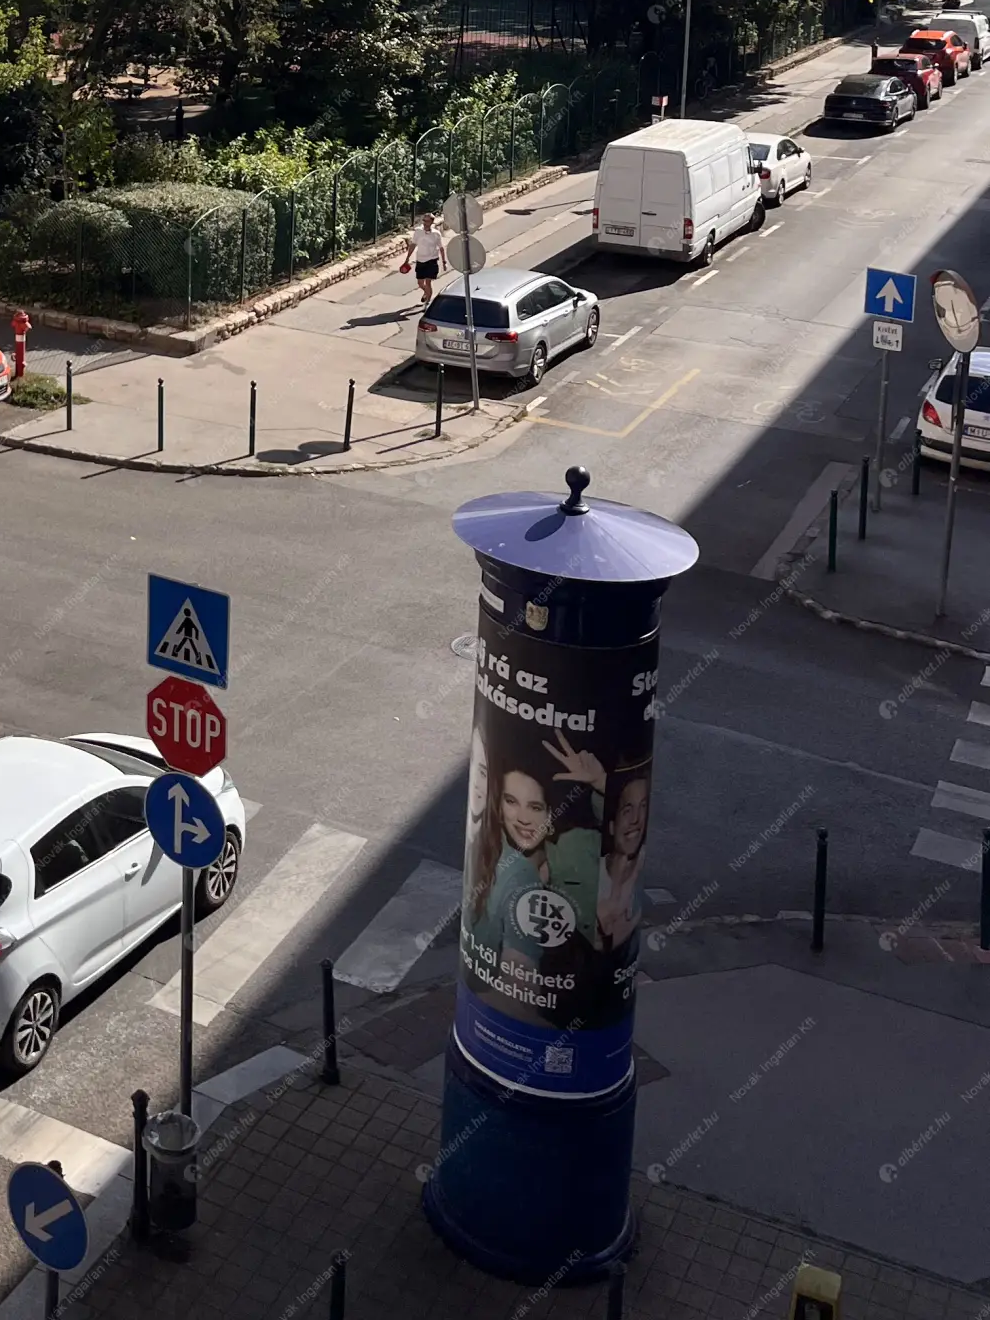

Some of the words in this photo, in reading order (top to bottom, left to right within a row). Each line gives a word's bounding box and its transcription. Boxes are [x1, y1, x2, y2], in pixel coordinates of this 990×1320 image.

[488, 655, 510, 680] rá
[515, 670, 549, 694] az
[152, 697, 221, 753] STOP
[477, 674, 596, 731] akásodra!
[528, 894, 565, 920] fix
[528, 913, 575, 945] 3%
[470, 934, 497, 967] 1-től
[500, 961, 576, 990] elérhető
[475, 960, 558, 1010] lakáshitel!
